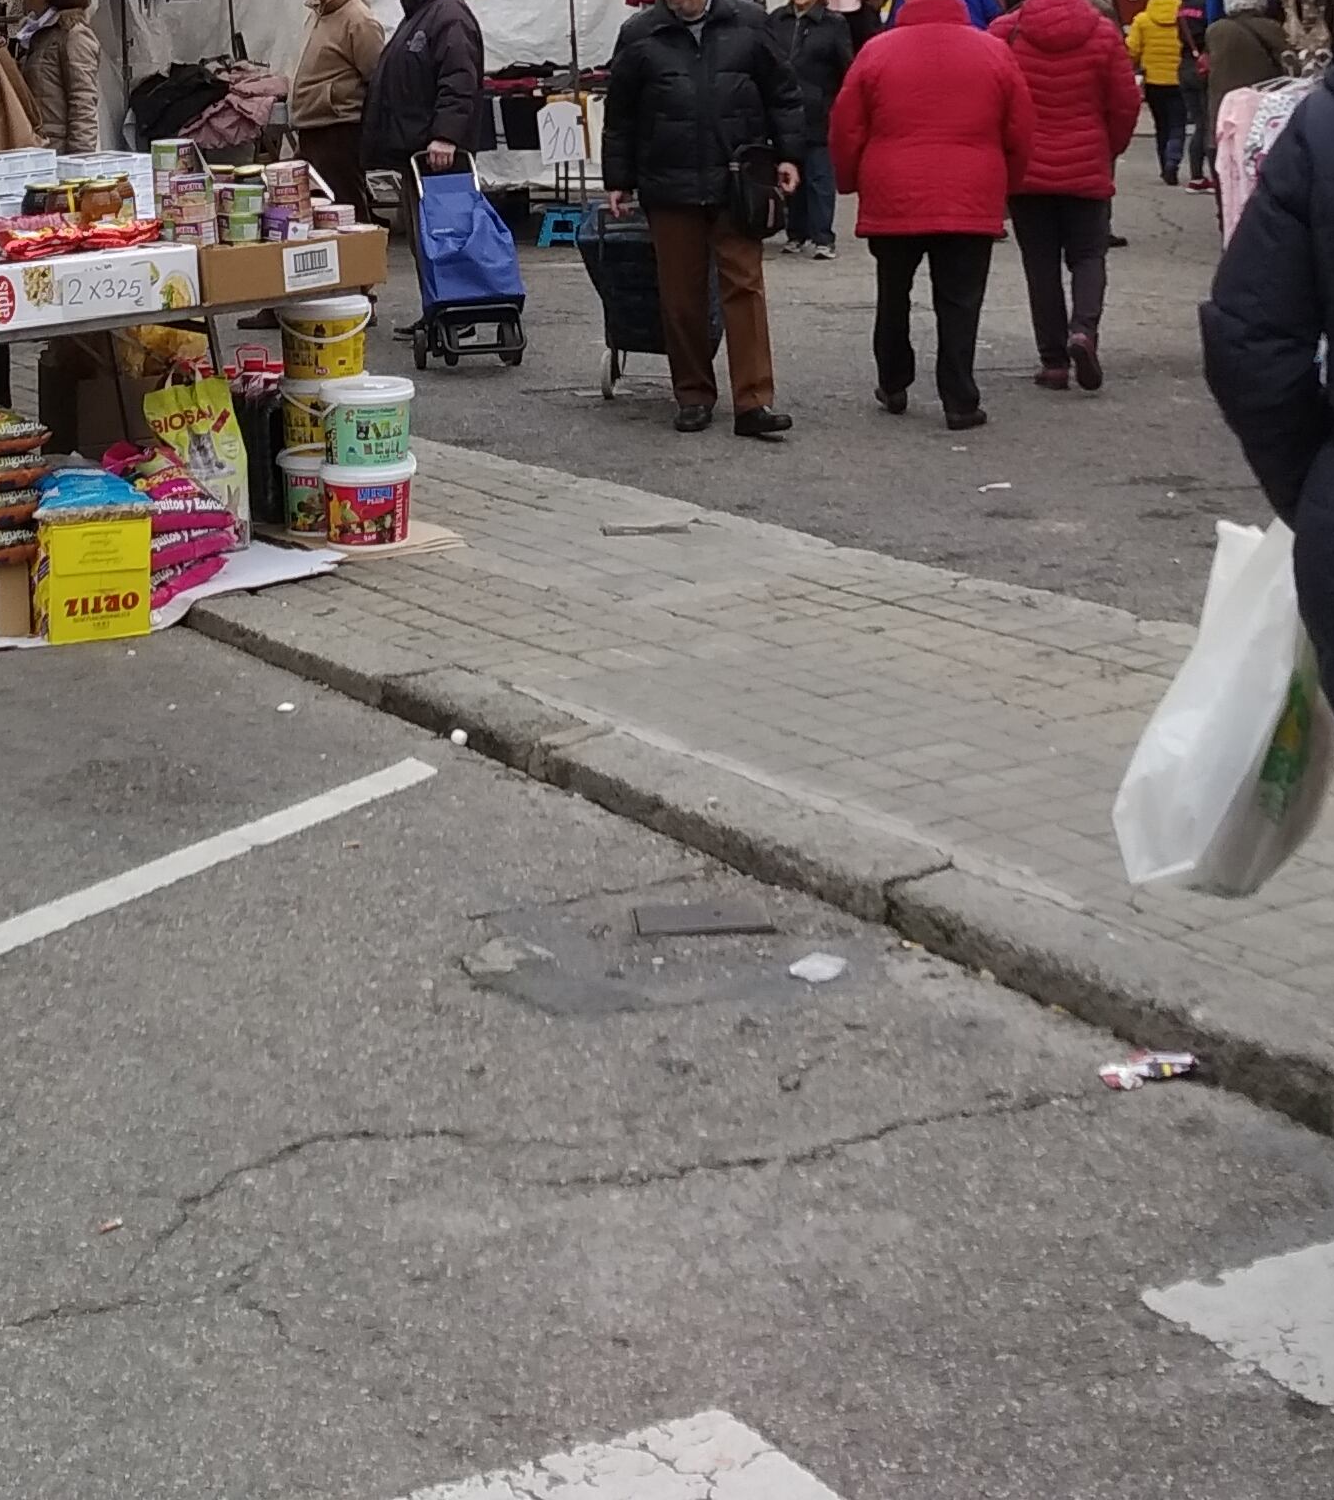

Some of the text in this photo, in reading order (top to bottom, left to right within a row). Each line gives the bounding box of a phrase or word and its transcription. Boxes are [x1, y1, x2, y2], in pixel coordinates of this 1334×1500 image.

[543, 110, 556, 131] A
[68, 278, 83, 306] 2
[153, 498, 185, 515] quitos
[64, 590, 141, 618] ORTIZ
